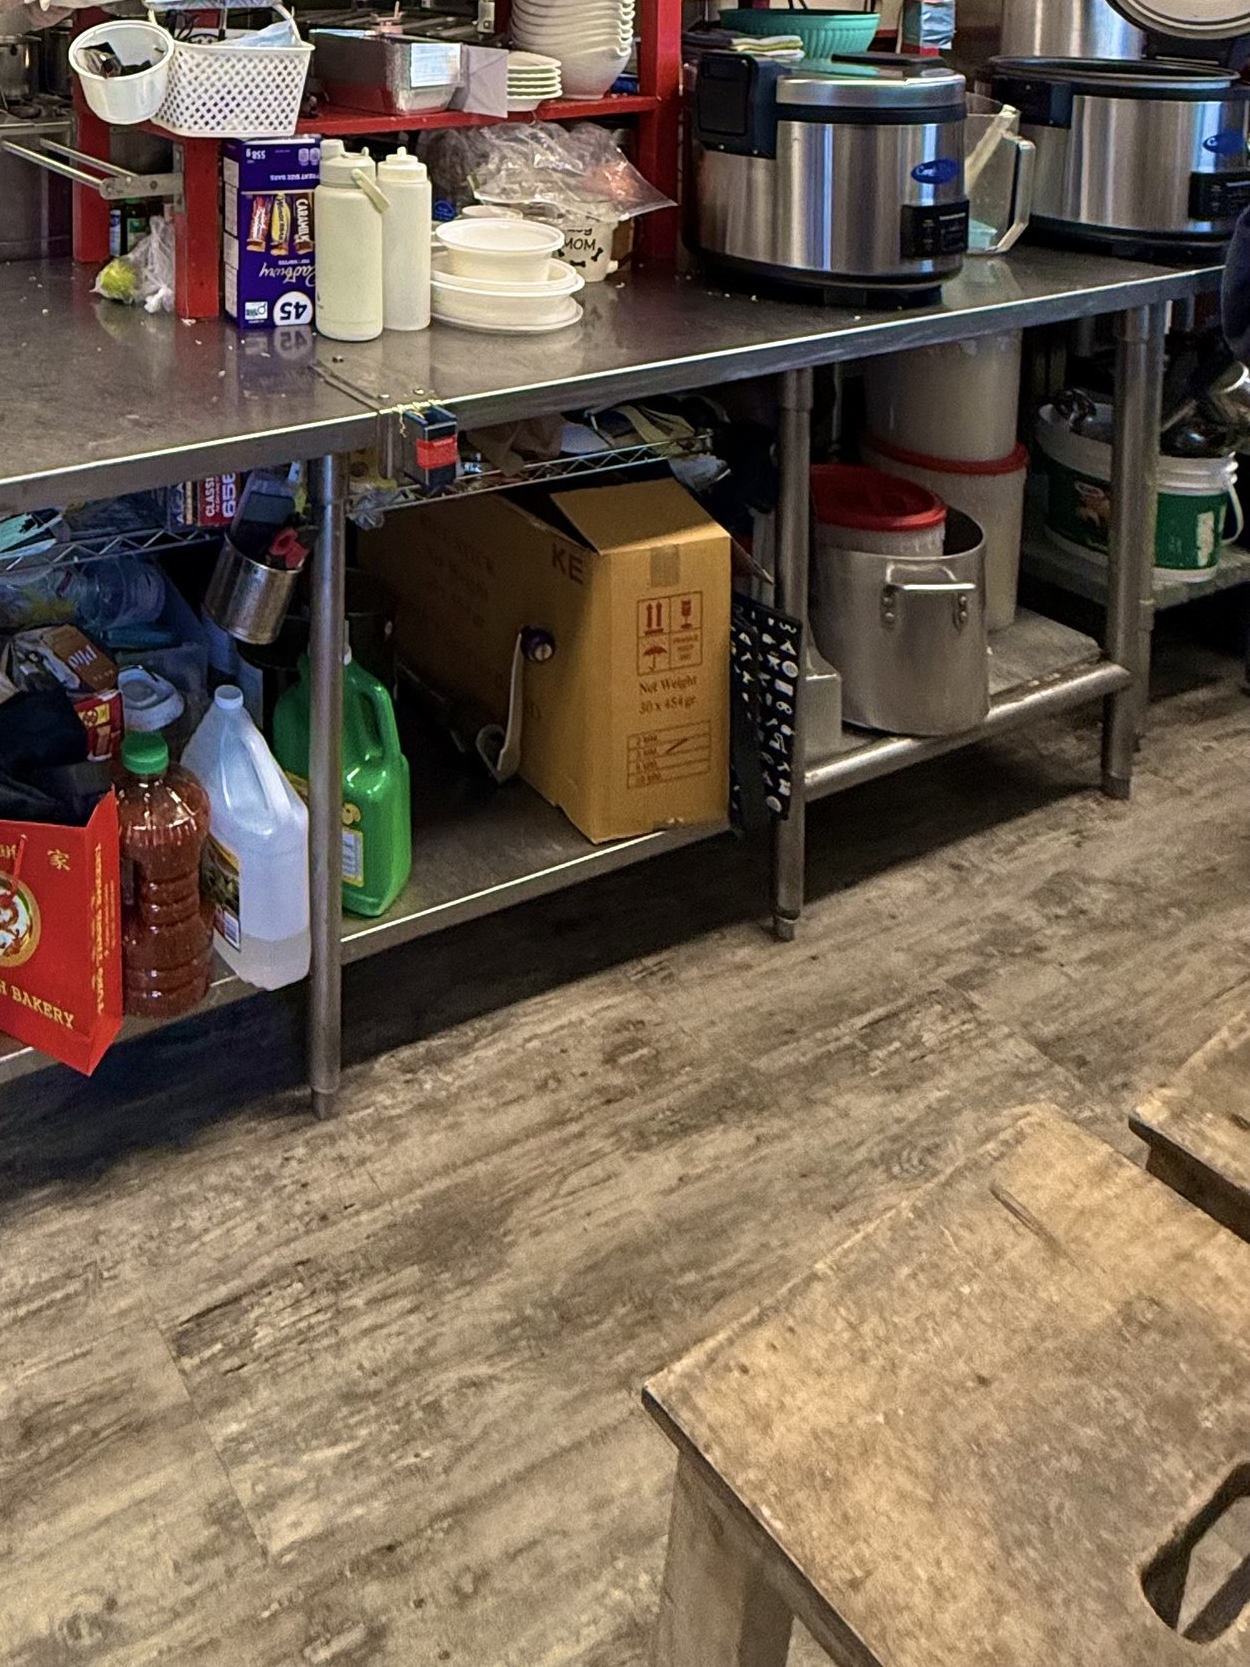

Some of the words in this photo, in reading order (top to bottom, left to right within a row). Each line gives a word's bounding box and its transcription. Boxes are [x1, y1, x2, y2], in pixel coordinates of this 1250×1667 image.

[564, 238, 596, 251] MOM
[280, 301, 308, 321] 45
[205, 477, 215, 517] CLASSI
[661, 675, 698, 691] Weight
[11, 985, 75, 1030] BAKERY
